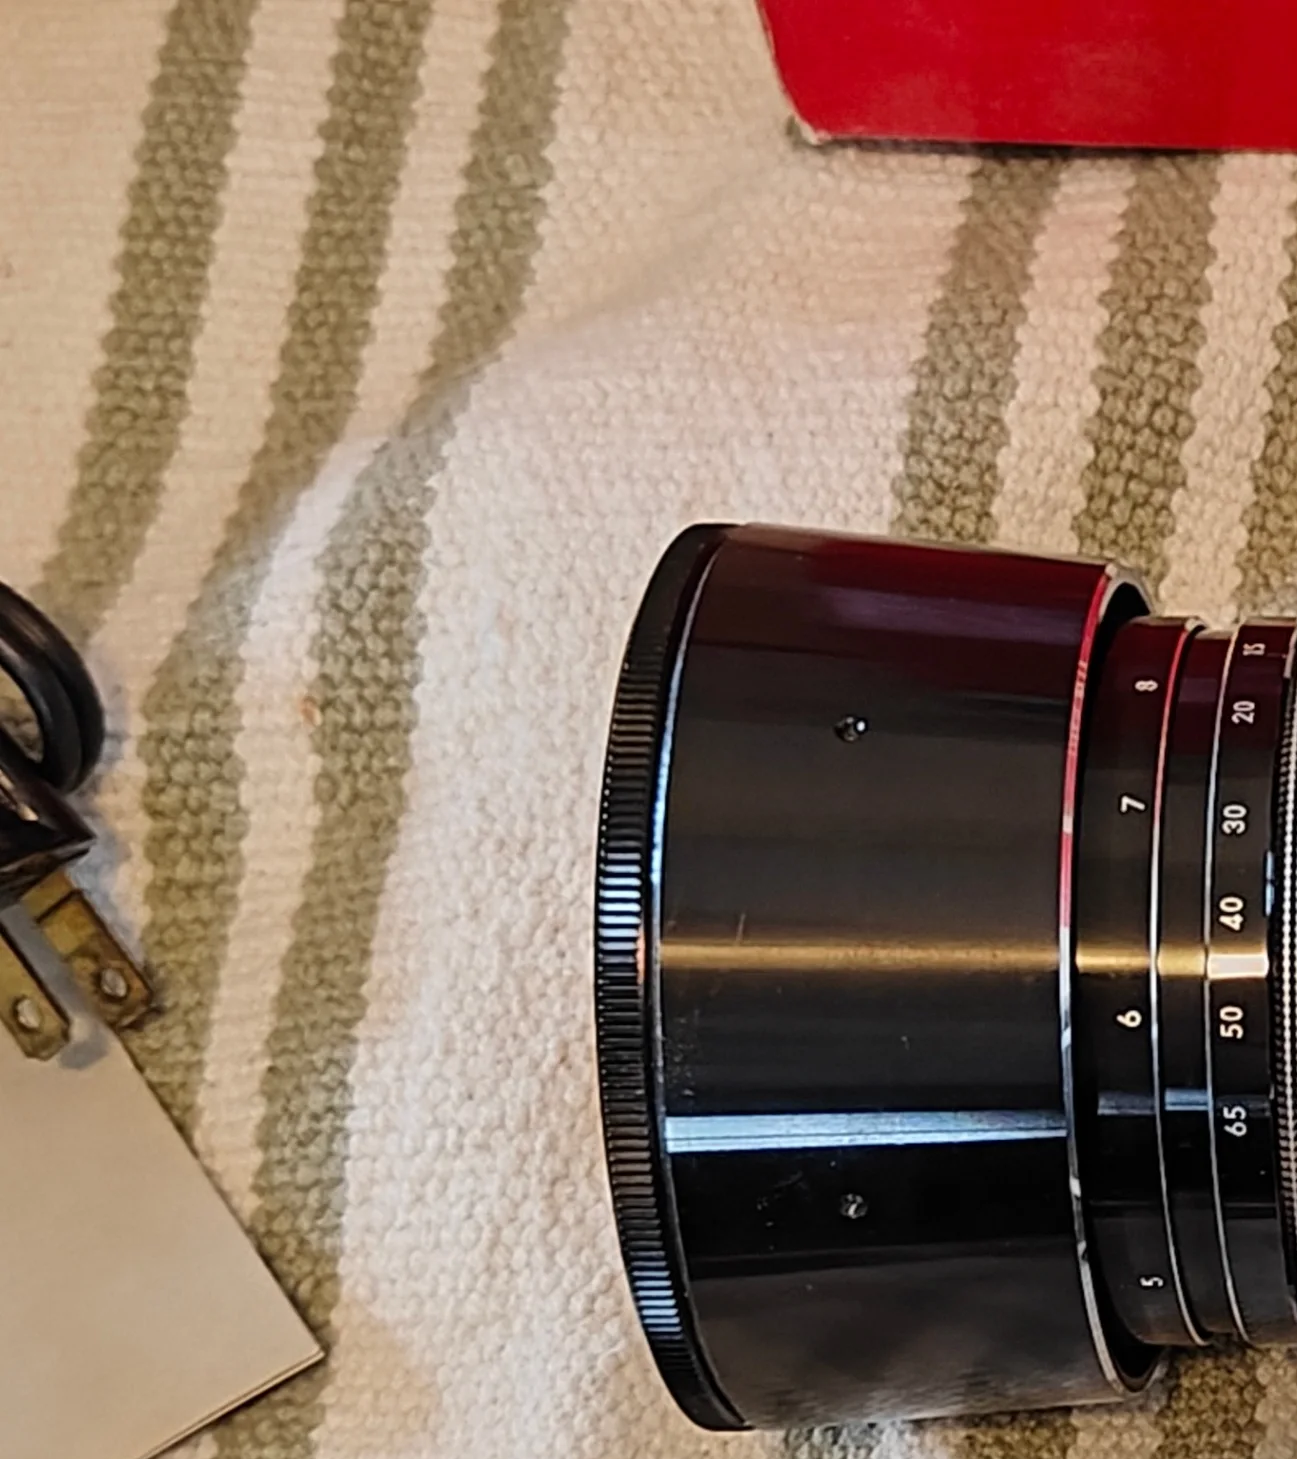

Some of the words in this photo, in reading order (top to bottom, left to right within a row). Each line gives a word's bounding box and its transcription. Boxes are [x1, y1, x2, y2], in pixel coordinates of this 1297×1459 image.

[1135, 680, 1159, 692] 8
[1231, 701, 1256, 724] 20
[1120, 796, 1146, 813] 7
[1222, 804, 1248, 834] 30
[1219, 897, 1244, 931] 40
[1117, 1009, 1142, 1028] 6
[1220, 1006, 1244, 1039] 50
[1223, 1105, 1247, 1137] 65
